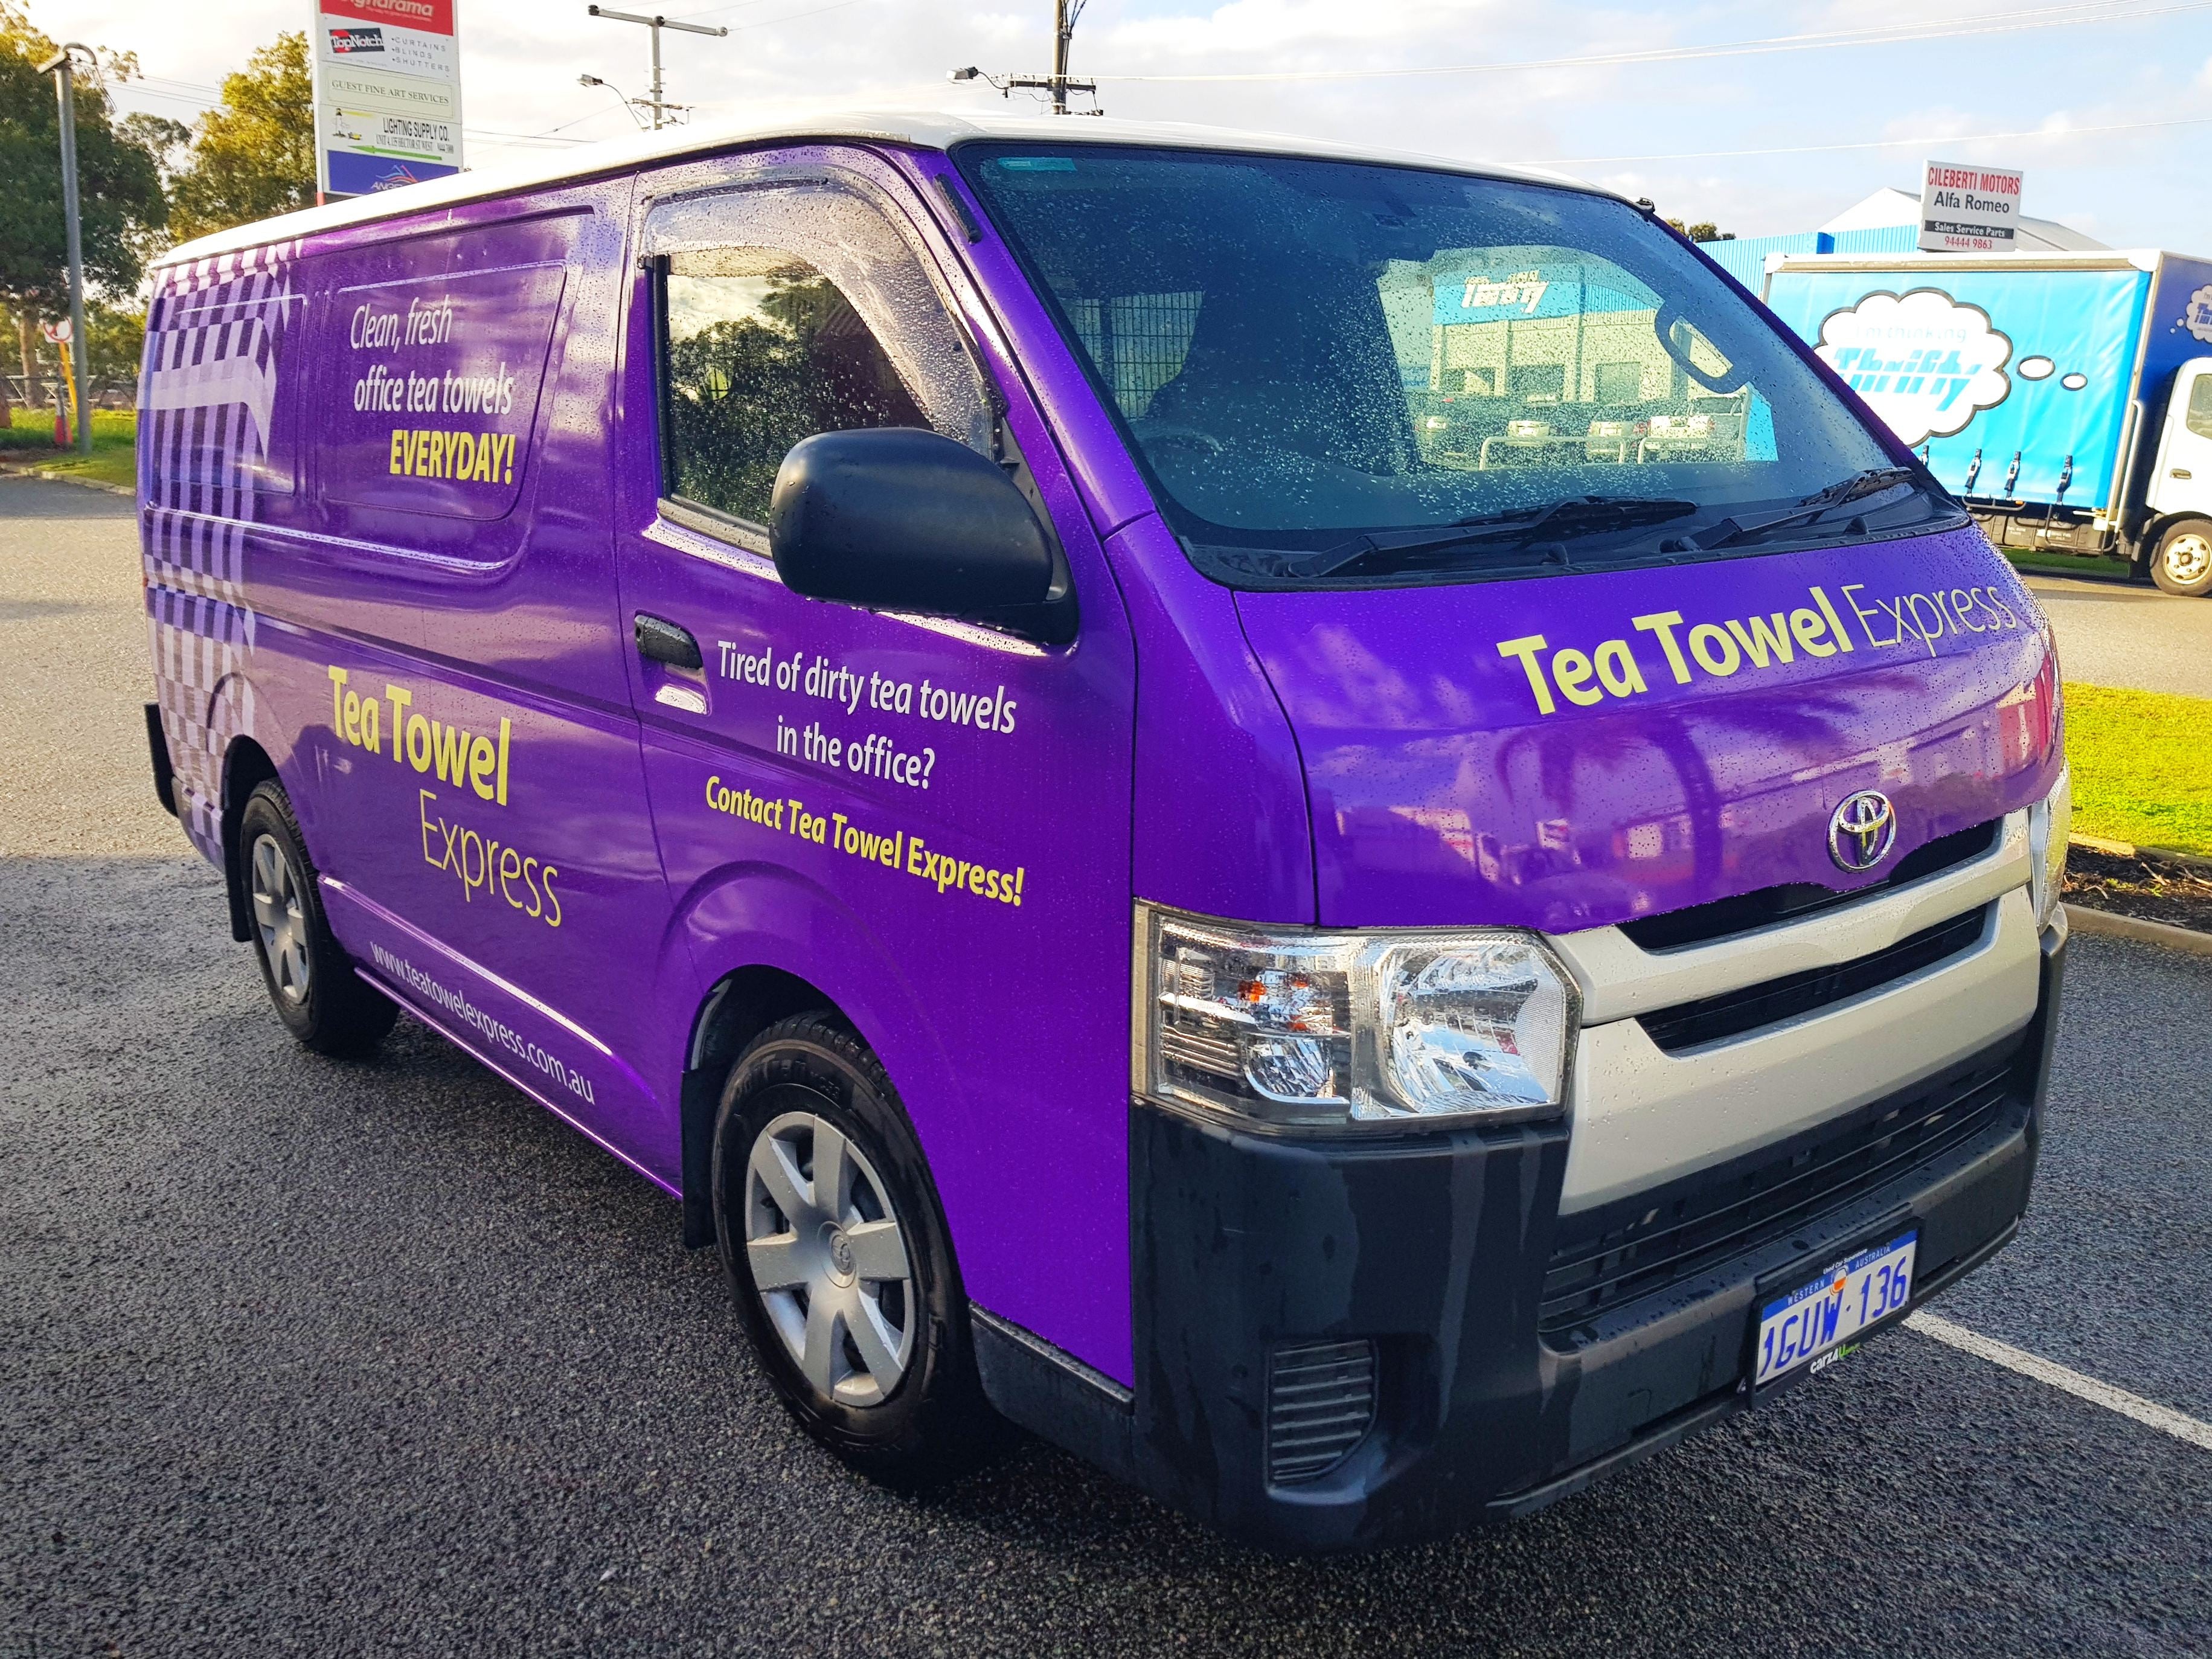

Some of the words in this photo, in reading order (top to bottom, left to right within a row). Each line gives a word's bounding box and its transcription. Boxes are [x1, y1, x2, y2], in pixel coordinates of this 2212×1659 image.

[341, 0, 434, 16] gnarama
[395, 37, 446, 51] CURTAINS
[395, 47, 432, 59] BLINDS
[396, 57, 449, 72] SHUTTERS
[332, 80, 362, 91] GUEST
[365, 84, 386, 94] FINE
[387, 89, 406, 98] ART
[408, 91, 449, 104] SERVICES
[383, 117, 412, 136] LIGHTING
[413, 121, 437, 140] SUPPLY
[438, 126, 450, 141] CO.
[1928, 167, 1977, 190] CILEBERTI
[1980, 173, 2020, 195] MOTORS
[1934, 191, 1960, 208] Alfa
[1965, 194, 2010, 213] Romeo
[1934, 222, 1954, 232] Sales
[1956, 224, 1984, 235] Service
[1986, 227, 2005, 237] Parts
[1972, 239, 1992, 249] 9863
[350, 304, 400, 353] Clean,
[405, 294, 452, 345] fresh
[354, 365, 403, 411] office
[407, 370, 438, 412] tea
[442, 362, 514, 414] towels
[390, 429, 515, 485] EVERYDAY!
[1496, 635, 1648, 715] Tea
[1631, 586, 1854, 685] Towel
[1841, 583, 2018, 657] Express
[717, 640, 771, 686] Tired
[776, 652, 803, 692] of
[805, 656, 864, 715] dirty
[870, 671, 912, 714] tea
[920, 679, 1017, 734] towels
[329, 665, 380, 754] Tea
[386, 684, 511, 806] Towel
[777, 715, 797, 756] in
[804, 722, 841, 766] the
[847, 734, 935, 789] office?
[420, 788, 562, 927] Express
[706, 775, 783, 830] Contact
[788, 799, 825, 844] Tea
[832, 812, 902, 868] Towel
[908, 836, 1025, 907] Express!
[370, 941, 595, 1105] www.teatowelexpress.com.au
[1787, 1279, 1825, 1306] WESTERN
[1855, 1247, 1891, 1269] AUSTRALIA
